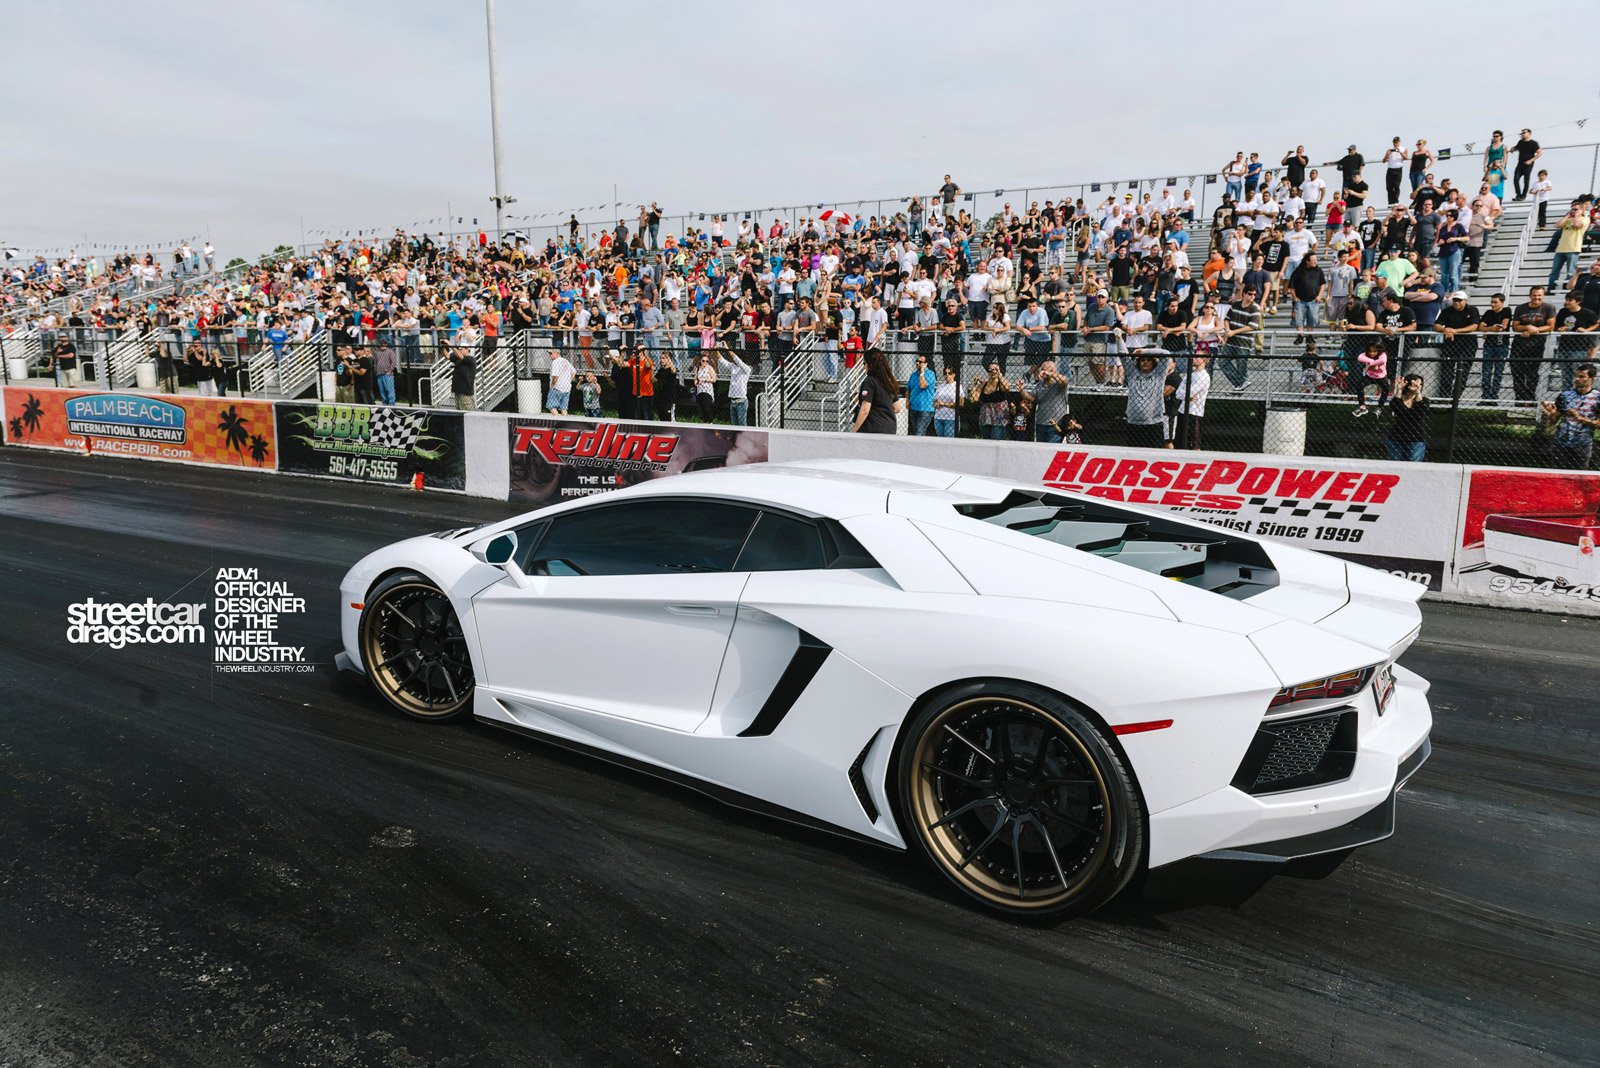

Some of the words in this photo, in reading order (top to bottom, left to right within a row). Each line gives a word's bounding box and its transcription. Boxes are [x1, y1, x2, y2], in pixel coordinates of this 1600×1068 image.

[75, 400, 115, 417] PALM
[117, 401, 174, 425] BEACH
[314, 404, 372, 439] BBR
[70, 421, 138, 438] INTERNATIONAL
[139, 427, 183, 441] RACEWAY
[64, 438, 192, 458] ww.RACEPBIR.com
[314, 440, 407, 458] www.BlowByRacing.com
[513, 423, 681, 465] Redline
[329, 456, 398, 480] 561-417-5555
[566, 457, 668, 472] motorsports
[577, 475, 599, 485] THE
[602, 475, 624, 485] LSX
[1190, 507, 1238, 515] Florida
[1256, 521, 1309, 539] Since
[1315, 526, 1364, 542] 1999
